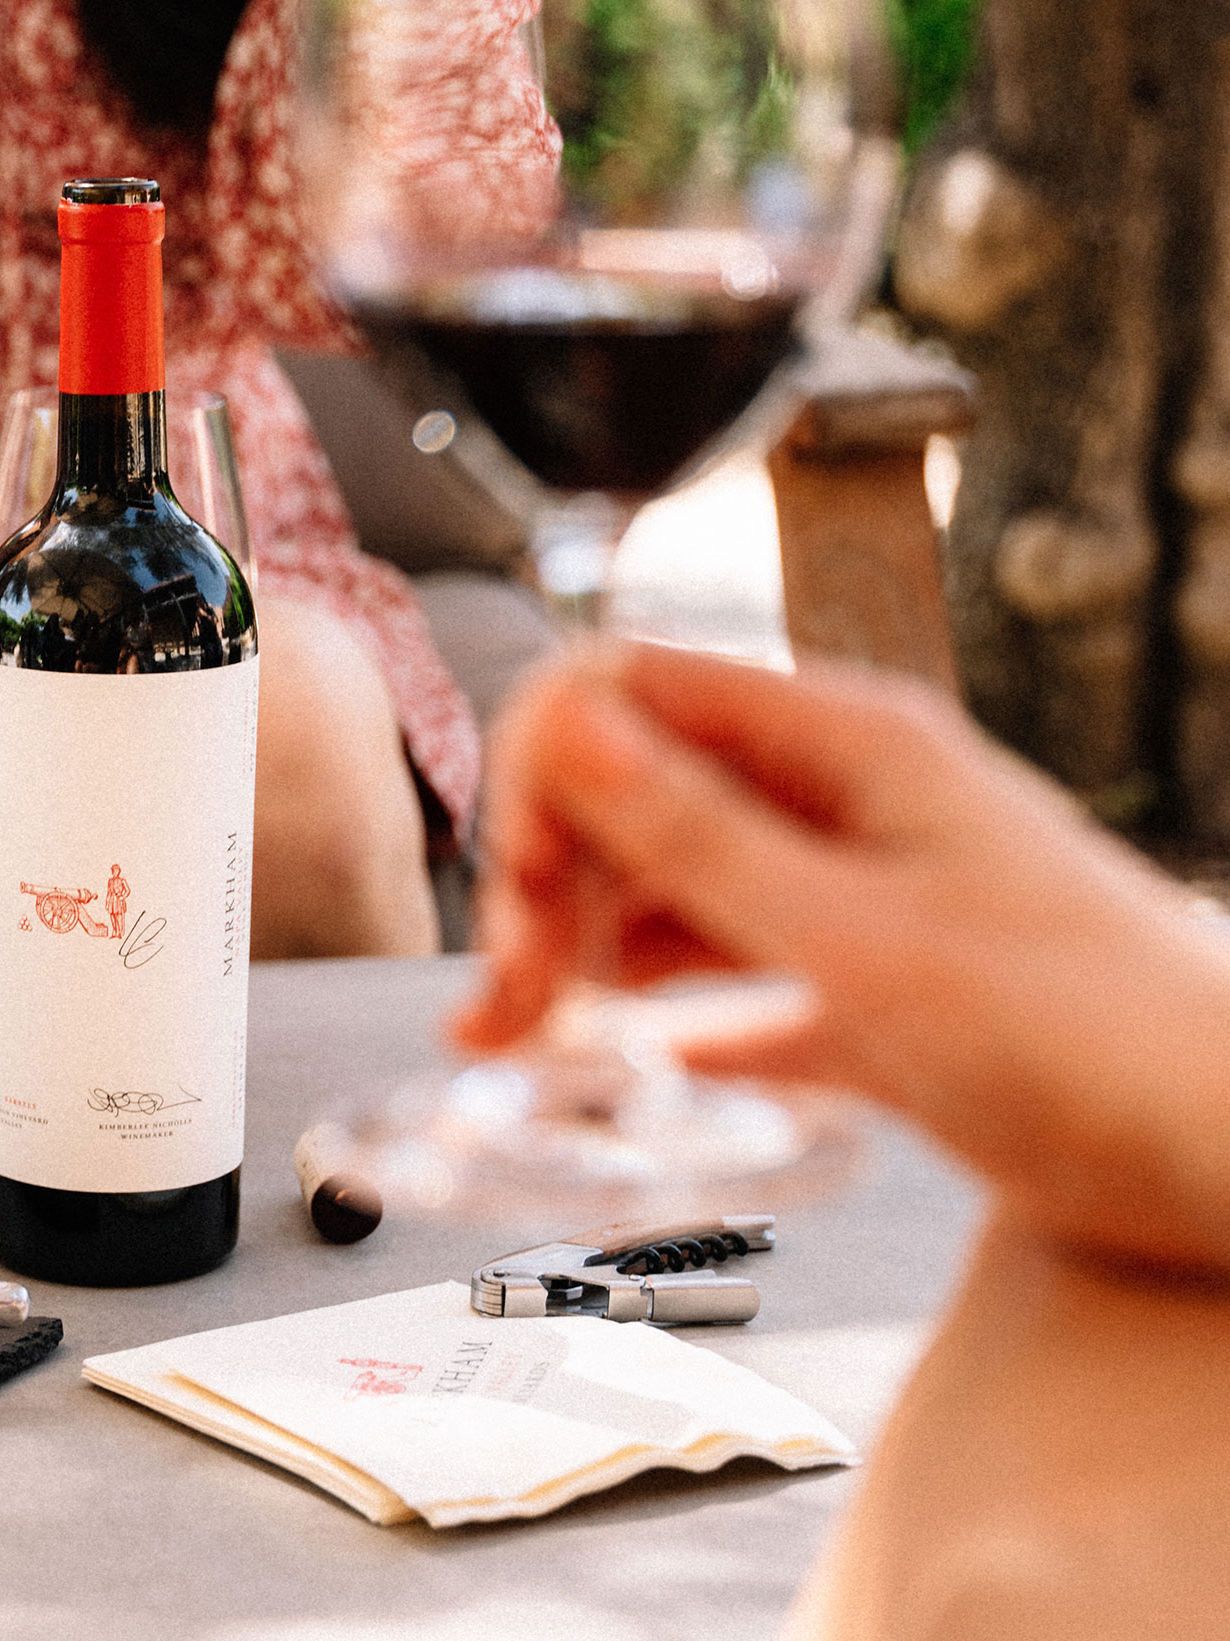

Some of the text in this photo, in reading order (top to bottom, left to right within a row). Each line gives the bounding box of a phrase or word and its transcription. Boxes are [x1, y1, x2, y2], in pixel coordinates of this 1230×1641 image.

[222, 831, 240, 977] MARKHAM
[98, 1122, 148, 1131] KIMBERLEE
[120, 1130, 174, 1140] WINEMAKER
